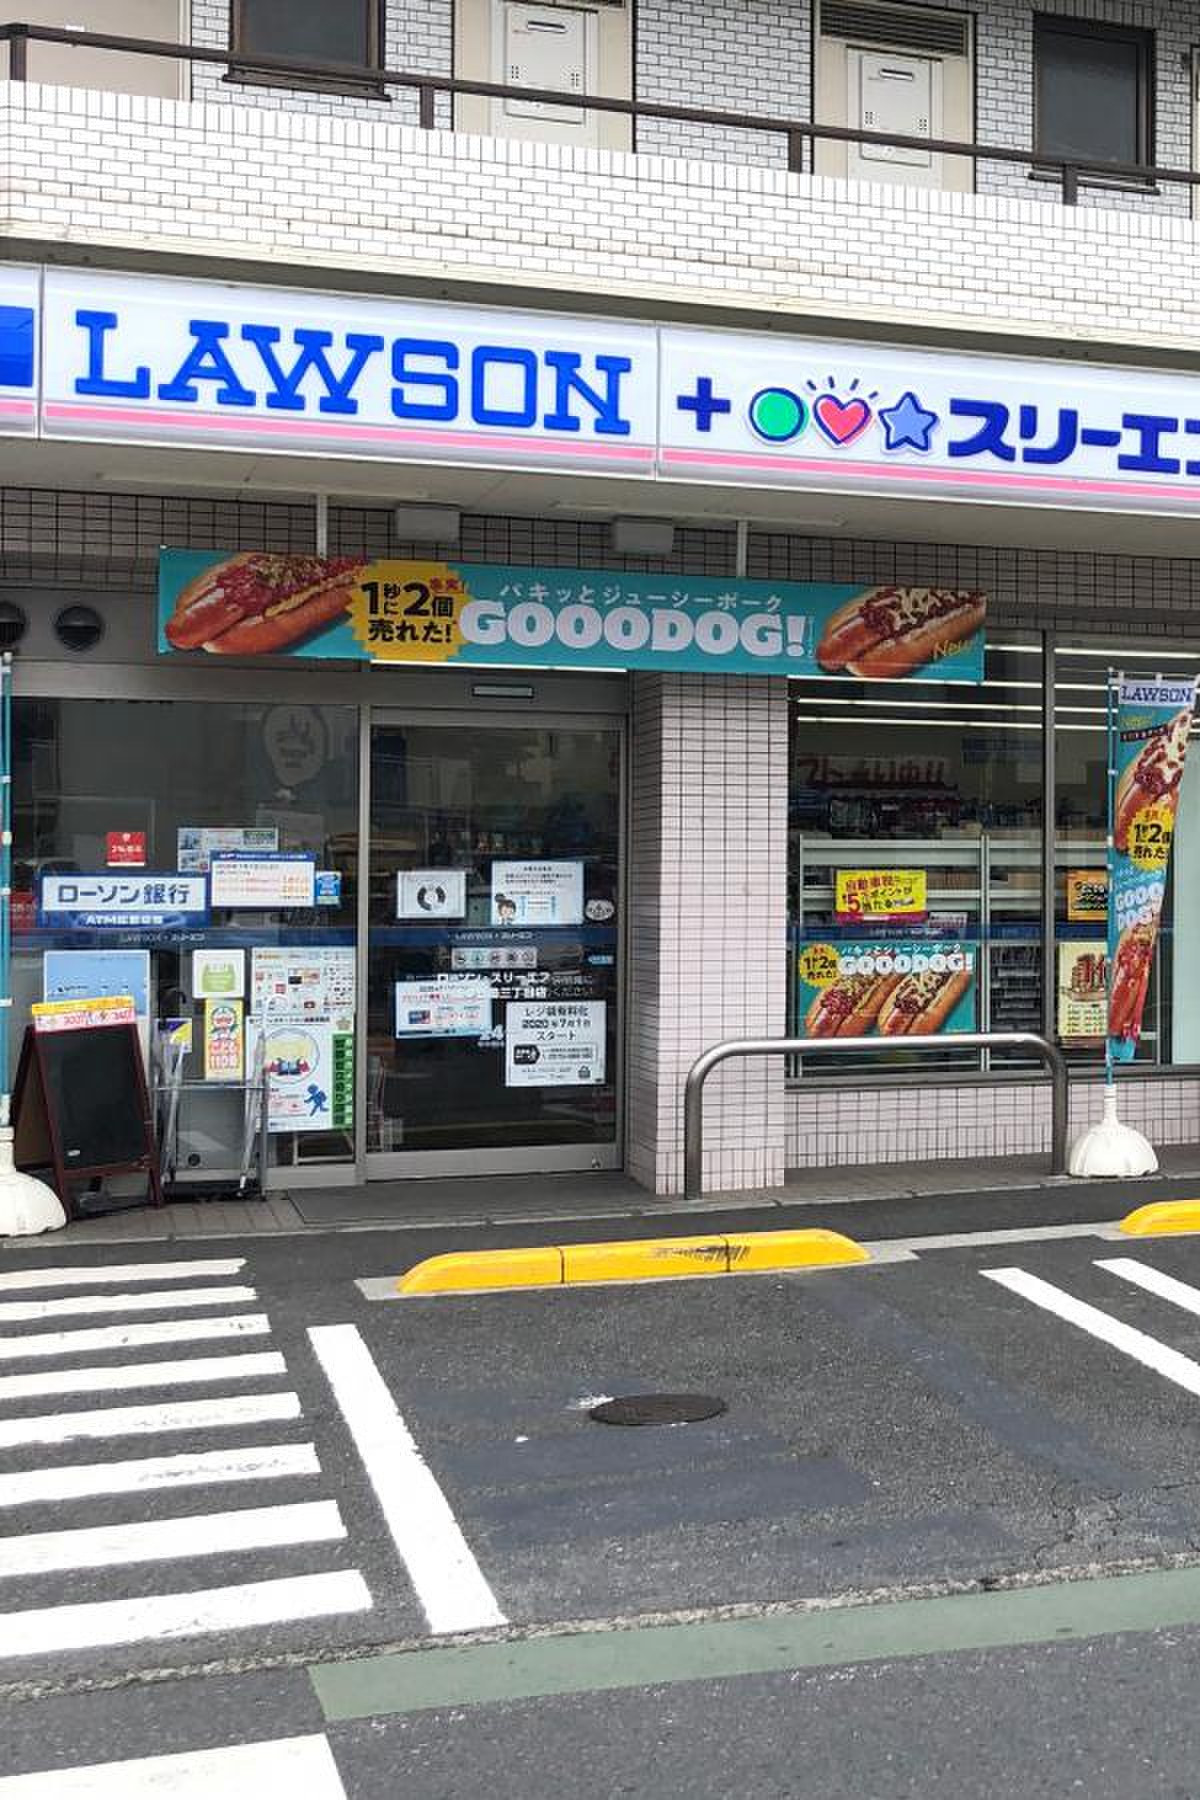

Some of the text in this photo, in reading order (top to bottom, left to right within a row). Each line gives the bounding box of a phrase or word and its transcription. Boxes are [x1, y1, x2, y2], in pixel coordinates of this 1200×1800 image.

[75, 310, 631, 435] LAWSON
[367, 619, 452, 643] 売れた!
[1121, 686, 1193, 703] LAWSON
[58, 883, 190, 905] ローソン銀行
[537, 1031, 577, 1041] スタート
